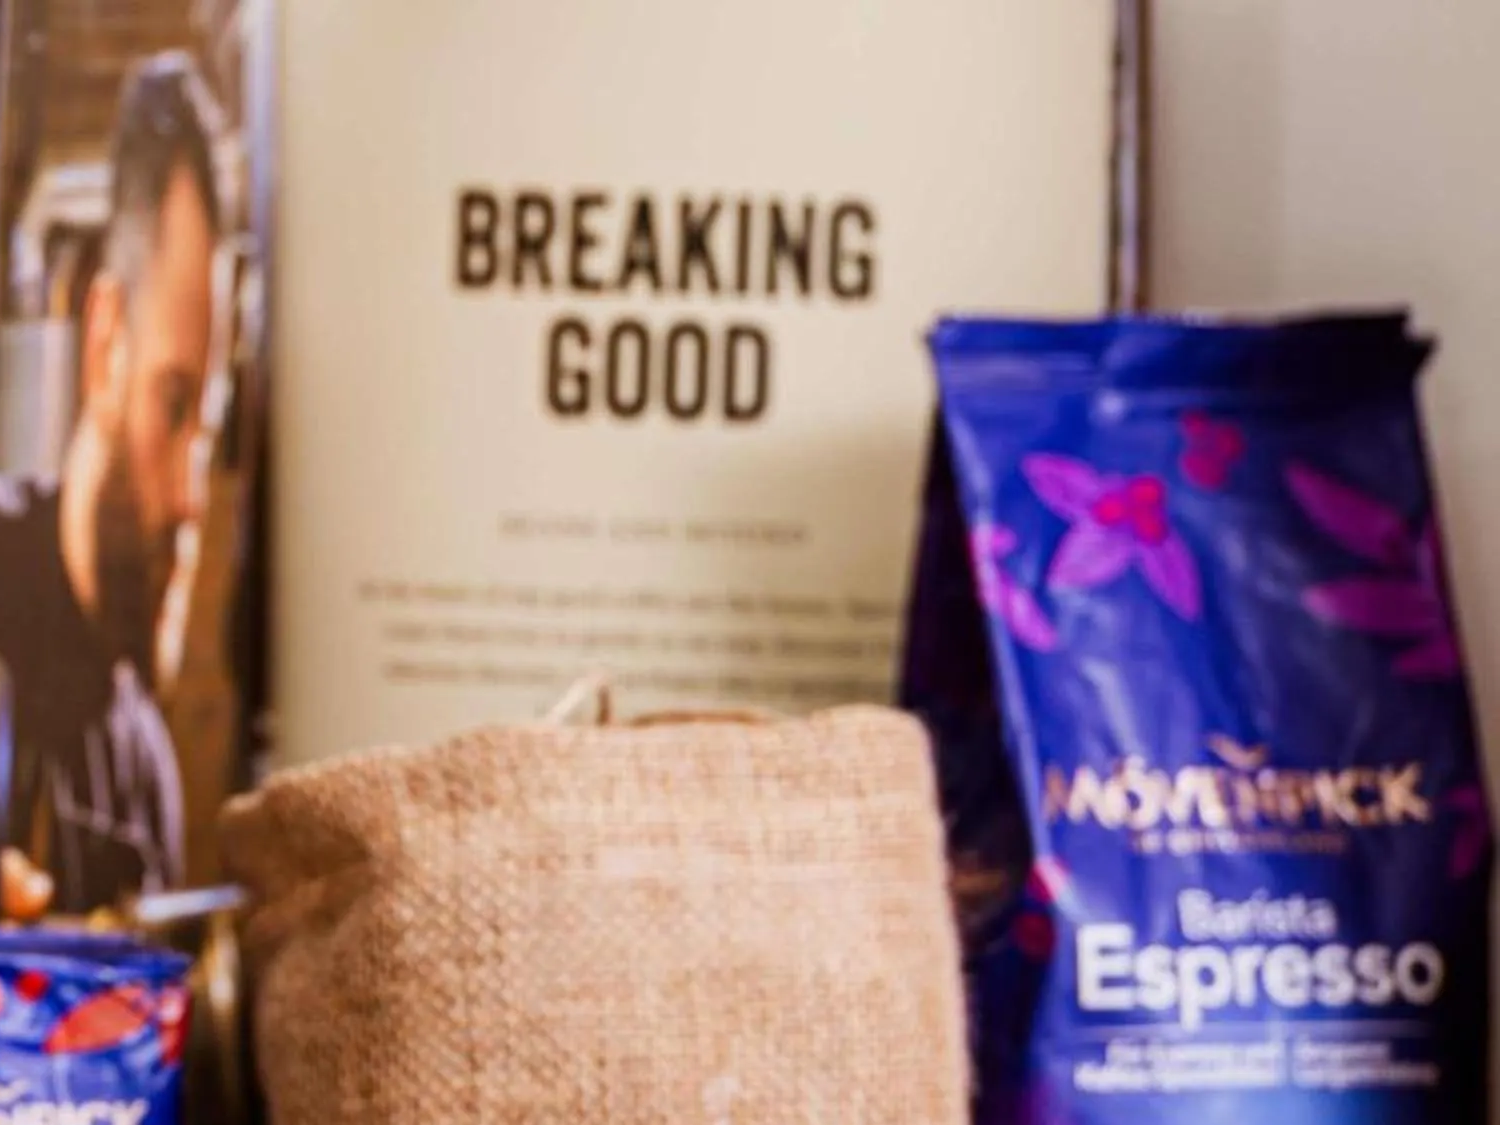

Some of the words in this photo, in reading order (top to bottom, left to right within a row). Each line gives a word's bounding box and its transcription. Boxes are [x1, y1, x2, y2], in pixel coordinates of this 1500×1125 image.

[453, 185, 878, 302] BREAKING
[545, 316, 774, 424] GOOD
[1073, 922, 1446, 1031] Espresso
